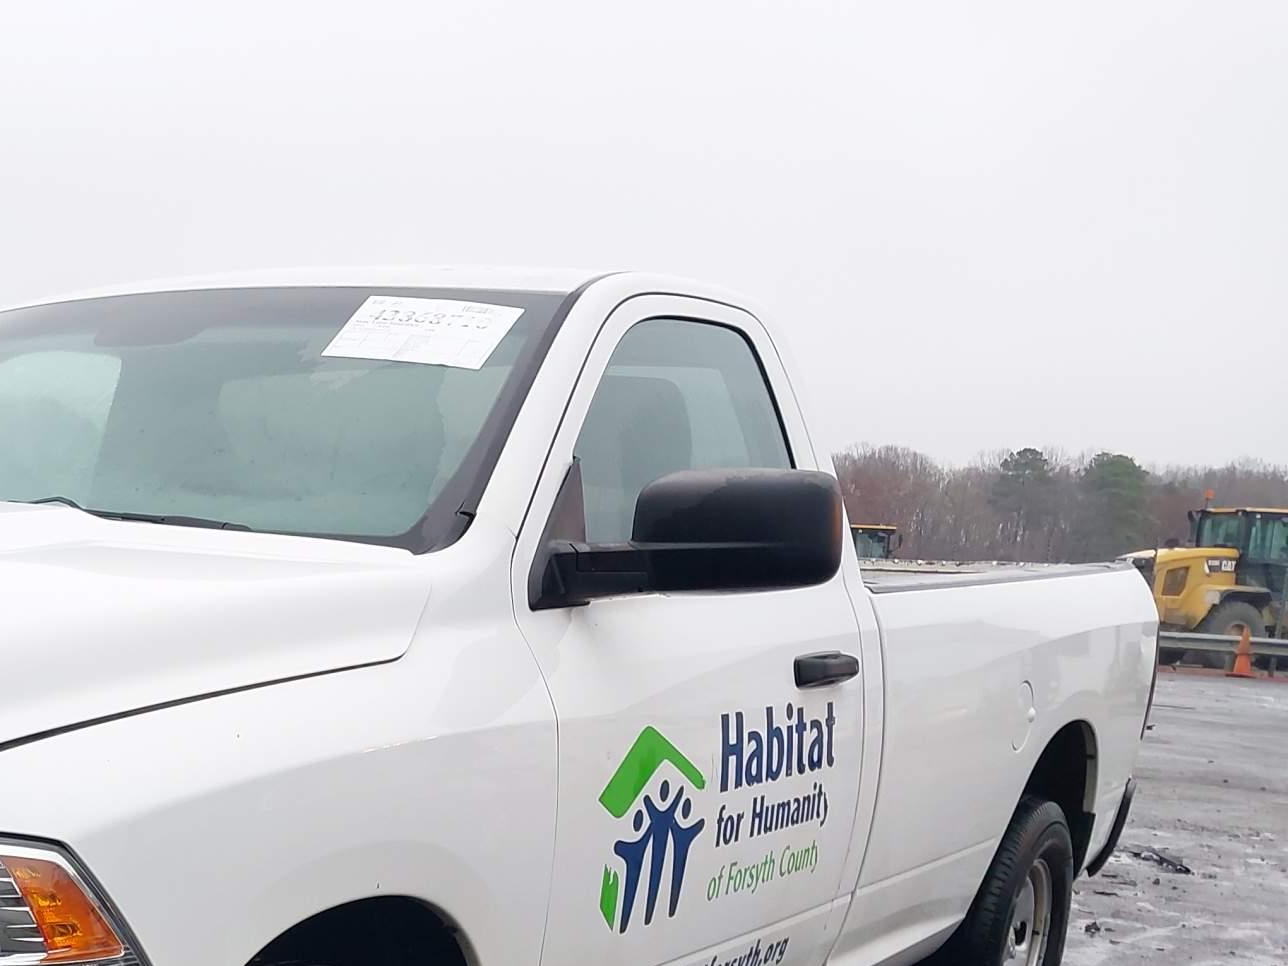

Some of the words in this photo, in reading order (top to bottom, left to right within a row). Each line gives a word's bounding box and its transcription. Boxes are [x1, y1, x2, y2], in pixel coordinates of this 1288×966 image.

[1221, 560, 1236, 572] CAT
[720, 701, 835, 792] Habitat
[715, 804, 743, 847] for
[749, 782, 828, 838] Humanity
[707, 865, 726, 902] of
[726, 850, 777, 895] Forsyth
[779, 839, 819, 878] County
